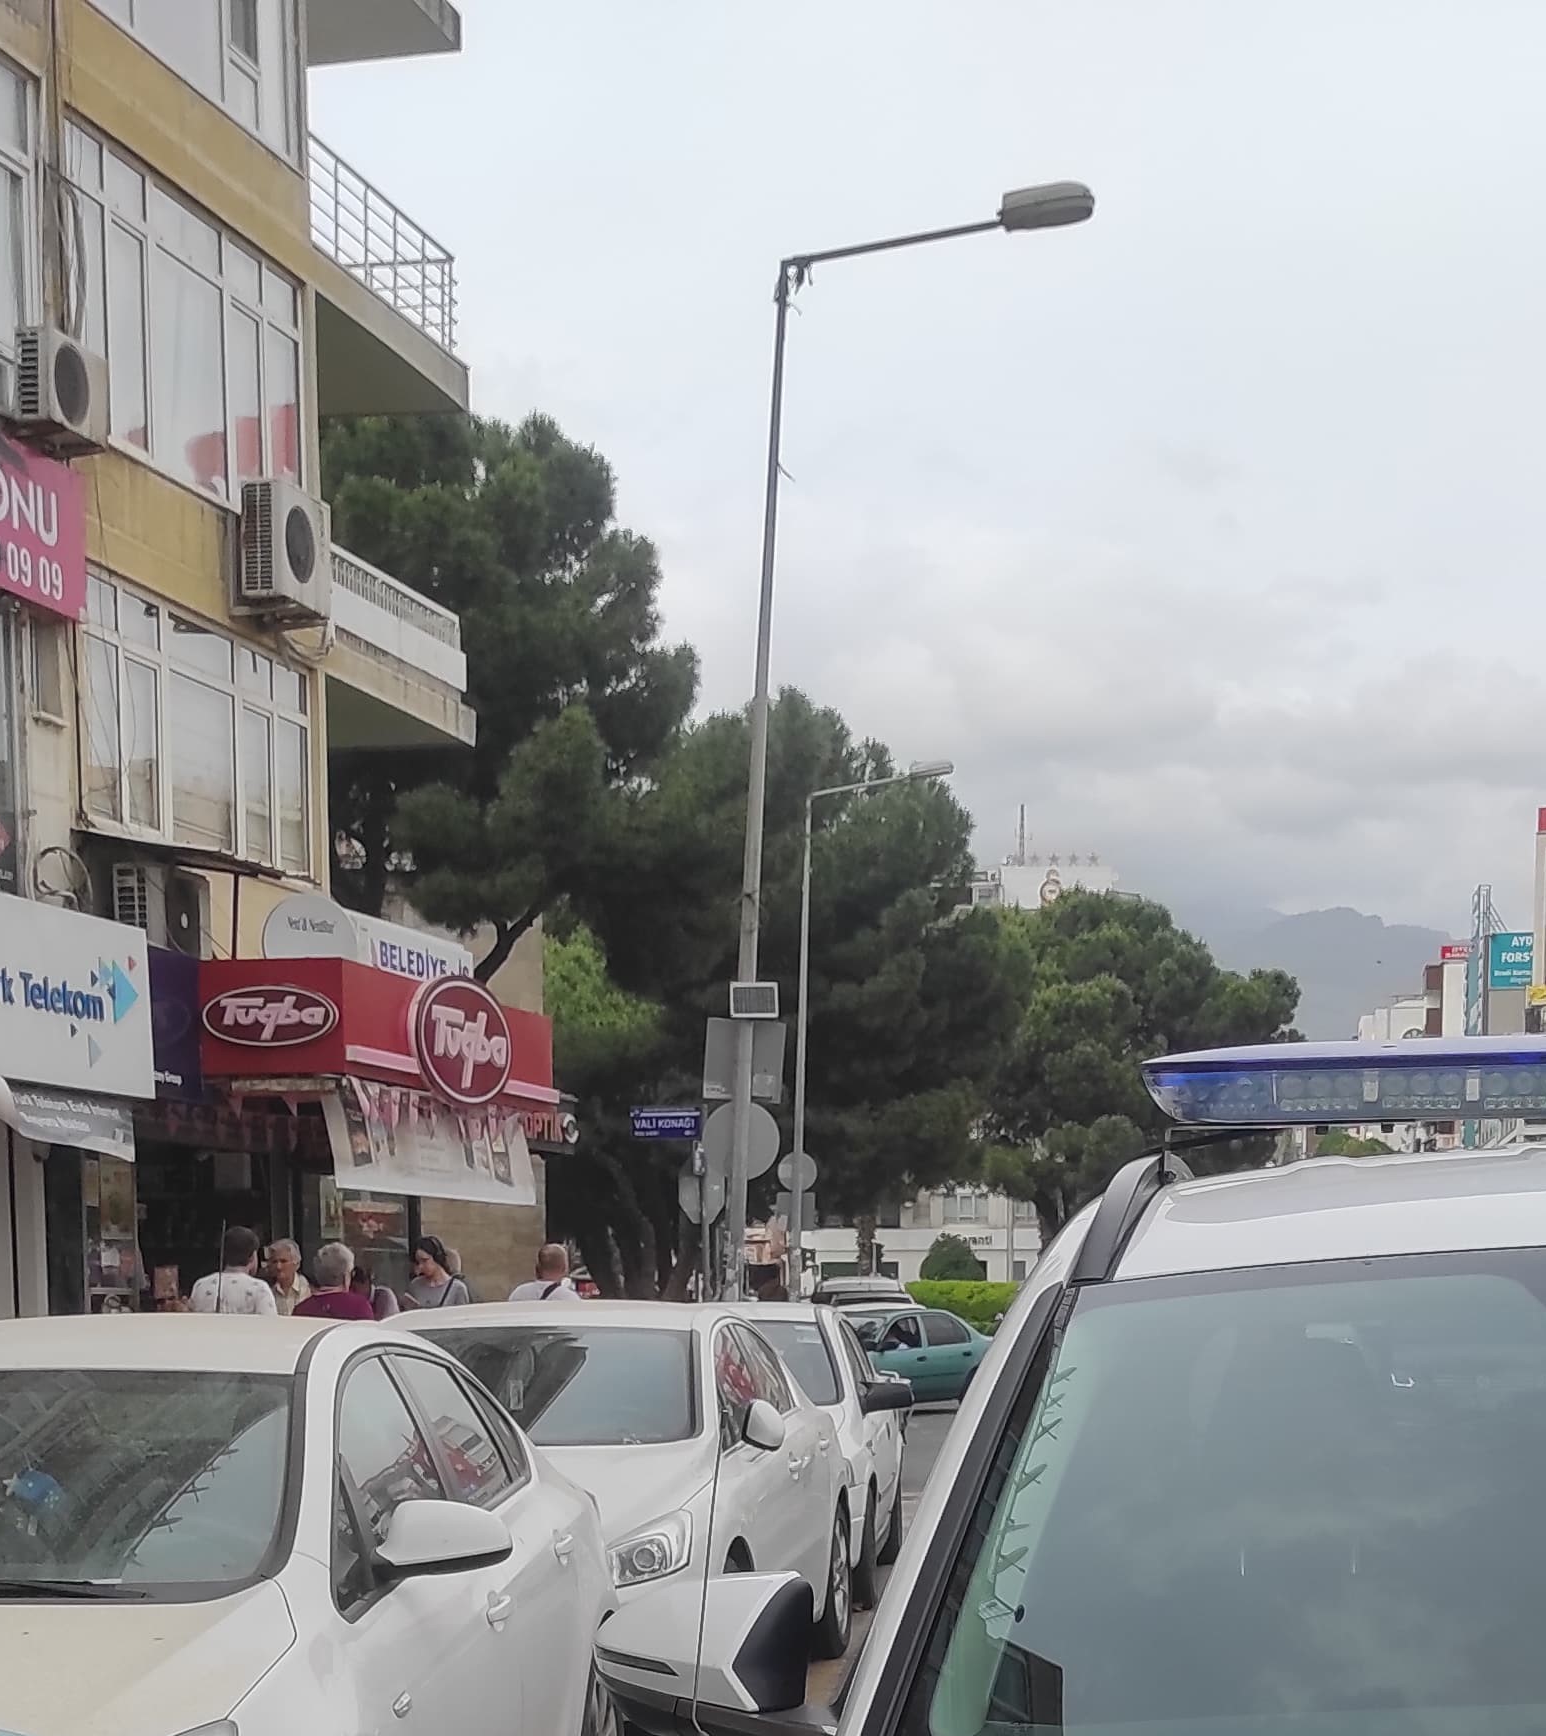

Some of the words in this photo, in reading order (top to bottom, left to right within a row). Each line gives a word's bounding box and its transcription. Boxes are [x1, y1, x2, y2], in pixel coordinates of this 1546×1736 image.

[6, 541, 33, 588] 09
[38, 556, 64, 601] 09
[19, 970, 105, 1022] Telekom
[657, 1116, 695, 1129] KONAĞI
